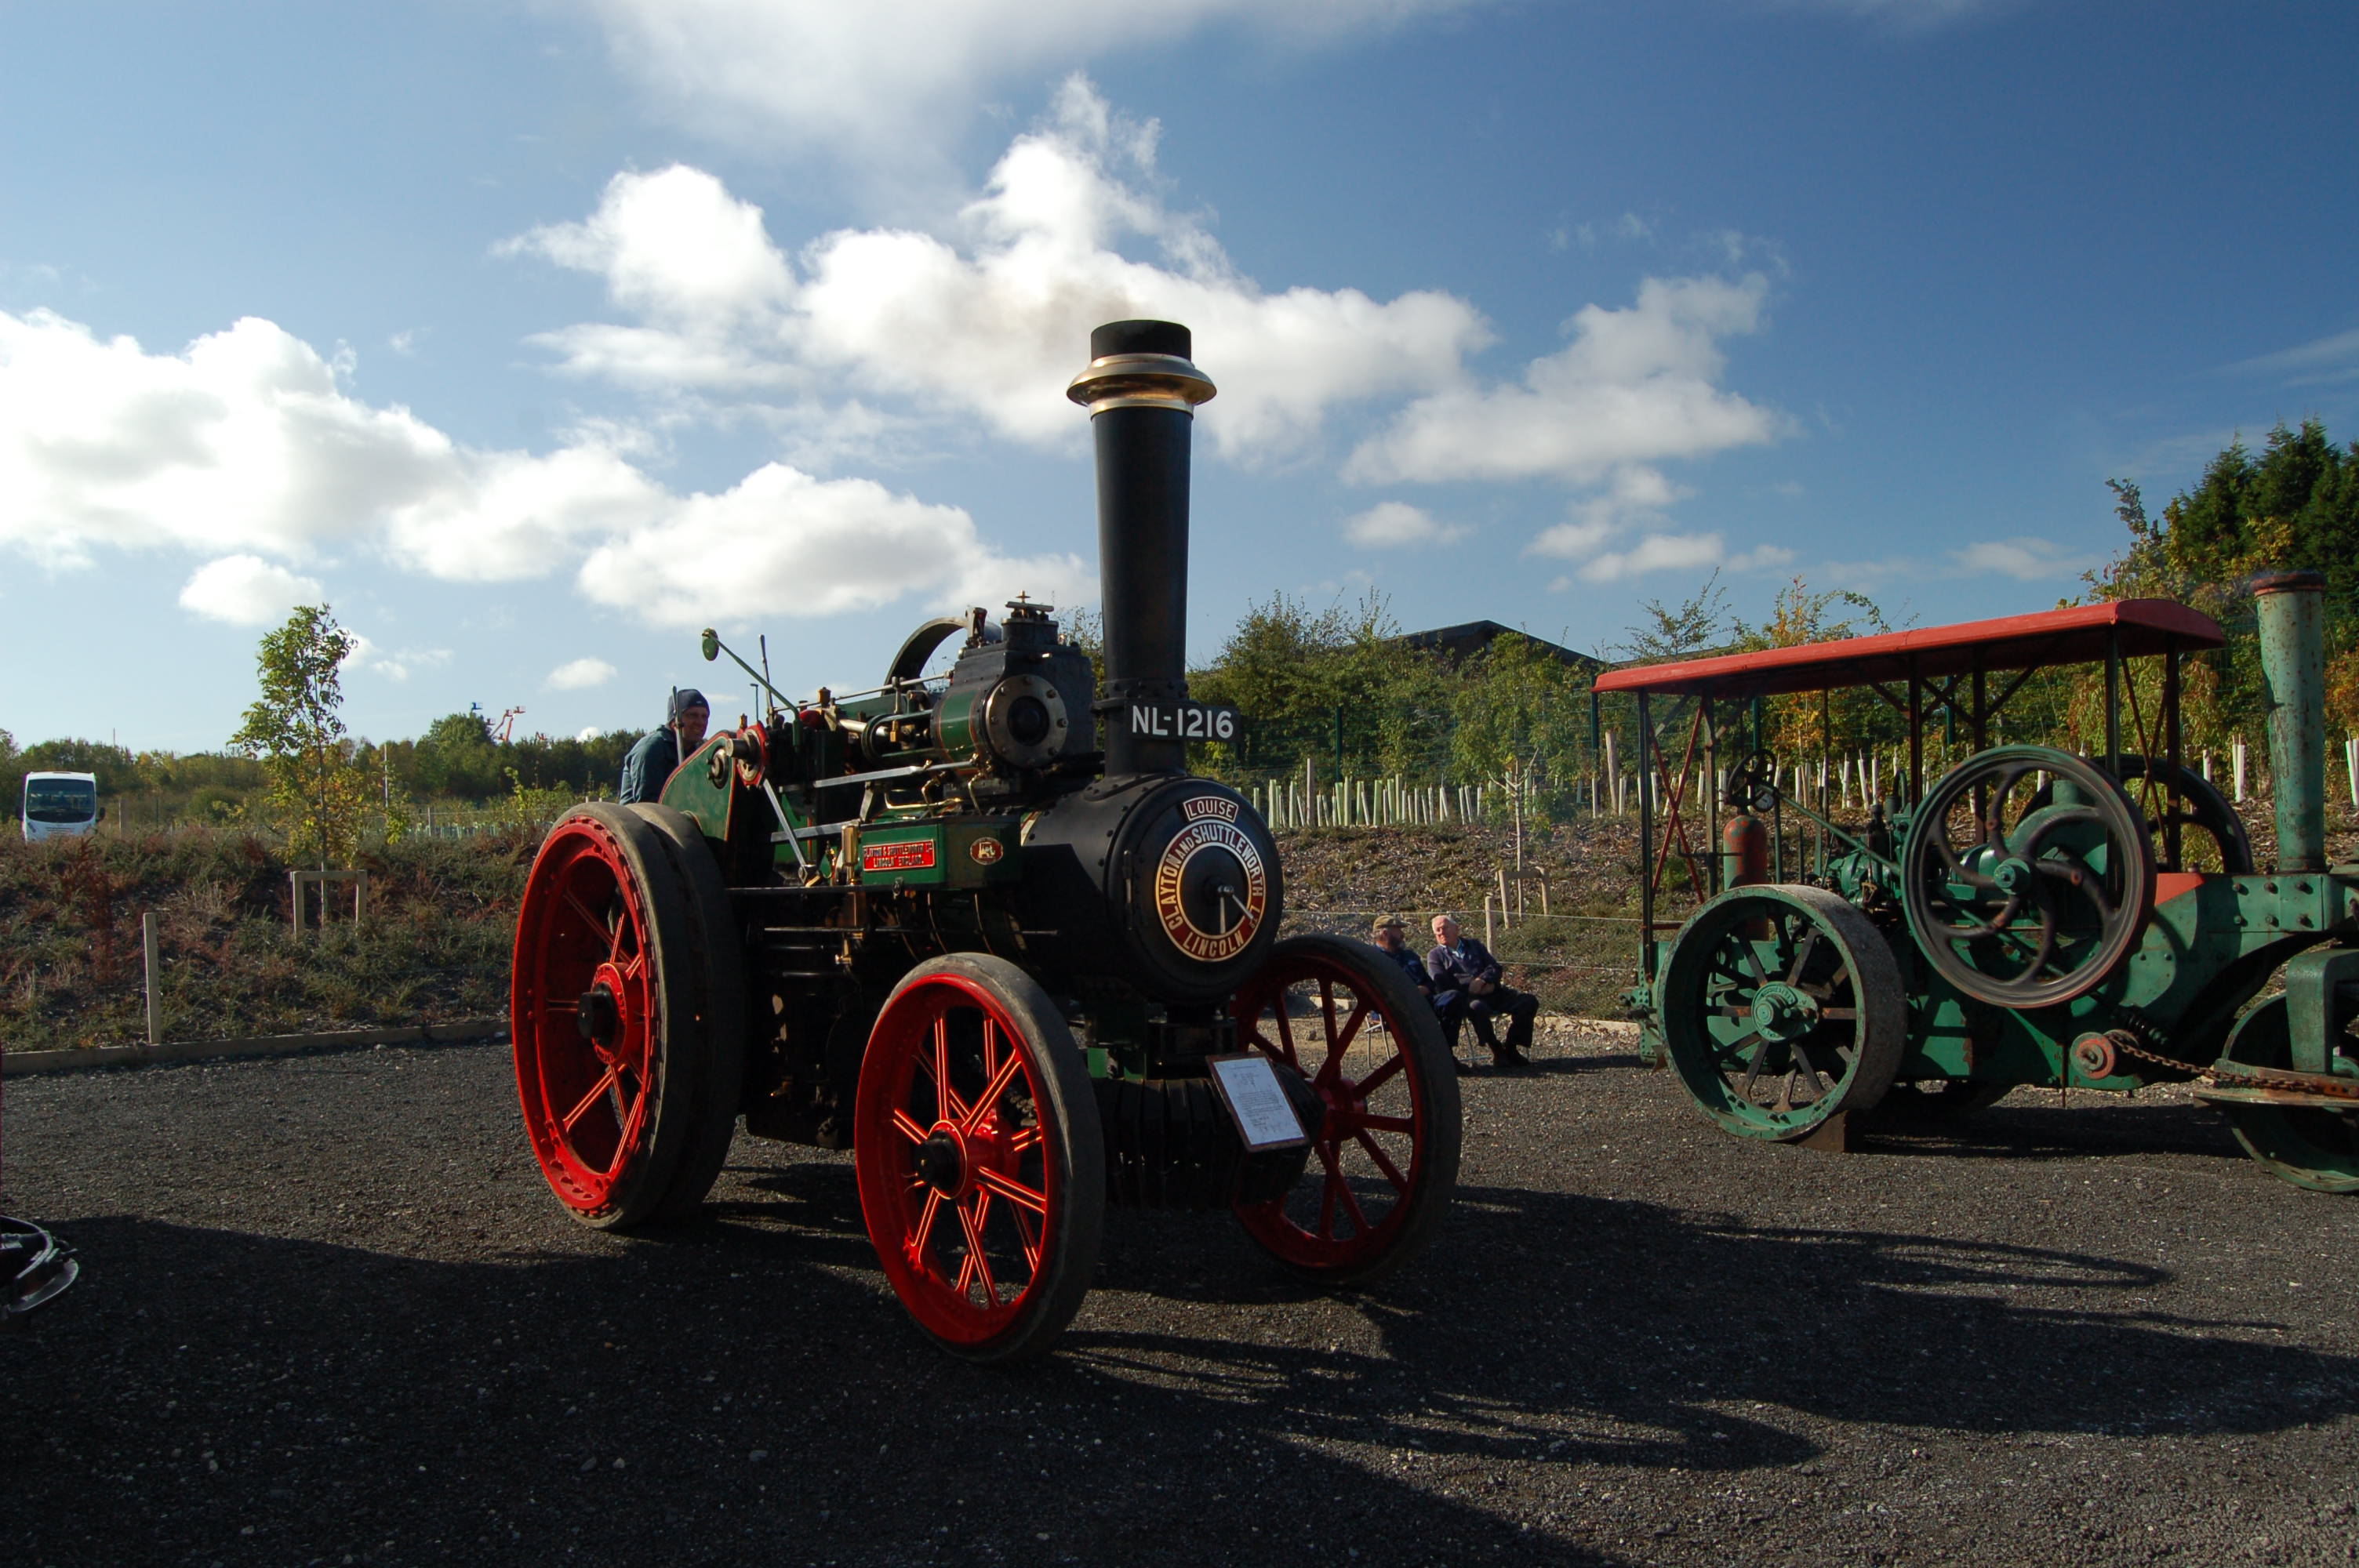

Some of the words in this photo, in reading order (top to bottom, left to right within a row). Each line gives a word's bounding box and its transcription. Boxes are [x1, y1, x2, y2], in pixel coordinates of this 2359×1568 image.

[1132, 705, 1234, 739] NL-1216
[1188, 800, 1234, 818] LOUISE
[1161, 852, 1184, 931] CLAYTON
[1178, 837, 1194, 858] AND
[1191, 824, 1263, 897] SHUTTLEWORTH
[1183, 931, 1244, 956] LINCOLN
